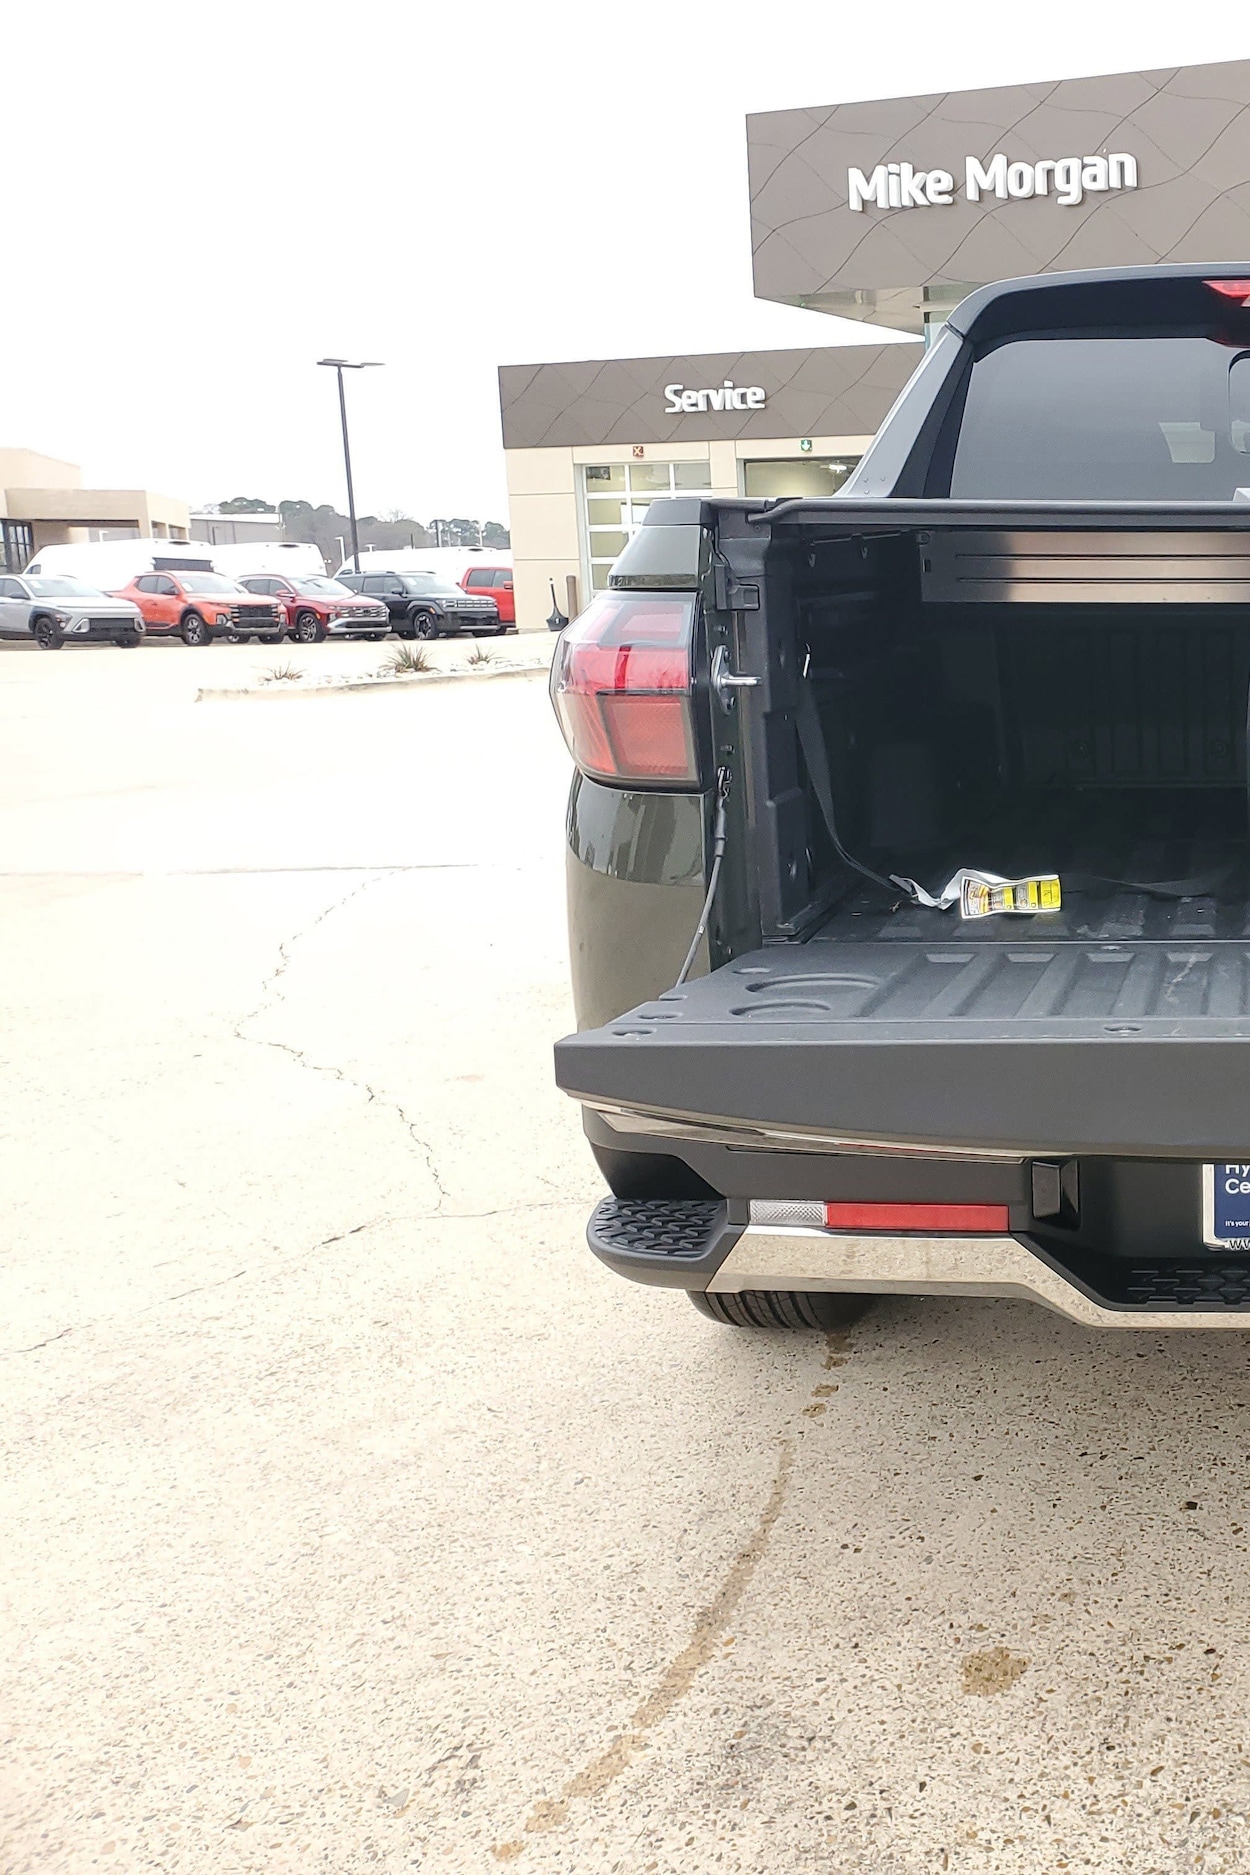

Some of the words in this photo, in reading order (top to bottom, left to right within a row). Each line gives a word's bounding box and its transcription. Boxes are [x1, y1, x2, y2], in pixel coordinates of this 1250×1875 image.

[848, 162, 954, 212] Mike
[965, 152, 1138, 206] Morgan
[664, 380, 766, 414] Service
[1235, 1220, 1249, 1228] your
